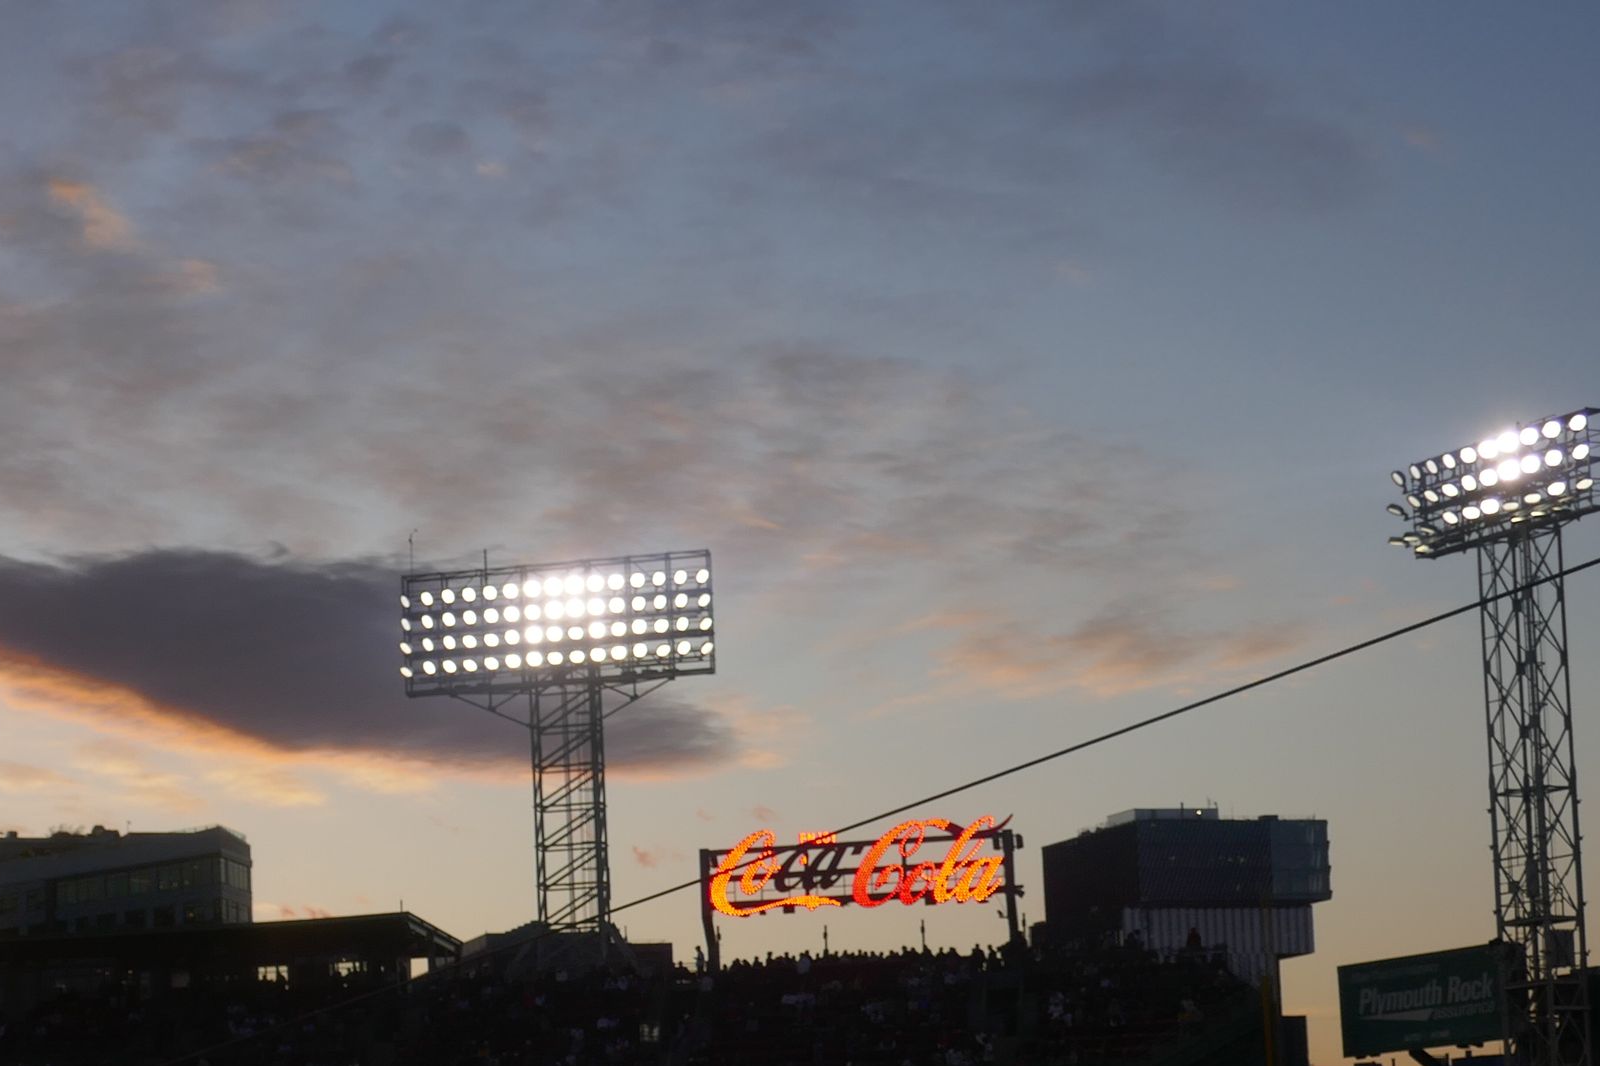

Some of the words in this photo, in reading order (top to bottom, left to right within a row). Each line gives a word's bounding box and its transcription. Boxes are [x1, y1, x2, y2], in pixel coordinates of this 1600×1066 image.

[1359, 978, 1442, 1015] Plymouth
[1447, 972, 1495, 1004] Rock
[1432, 1001, 1496, 1021] assurance
